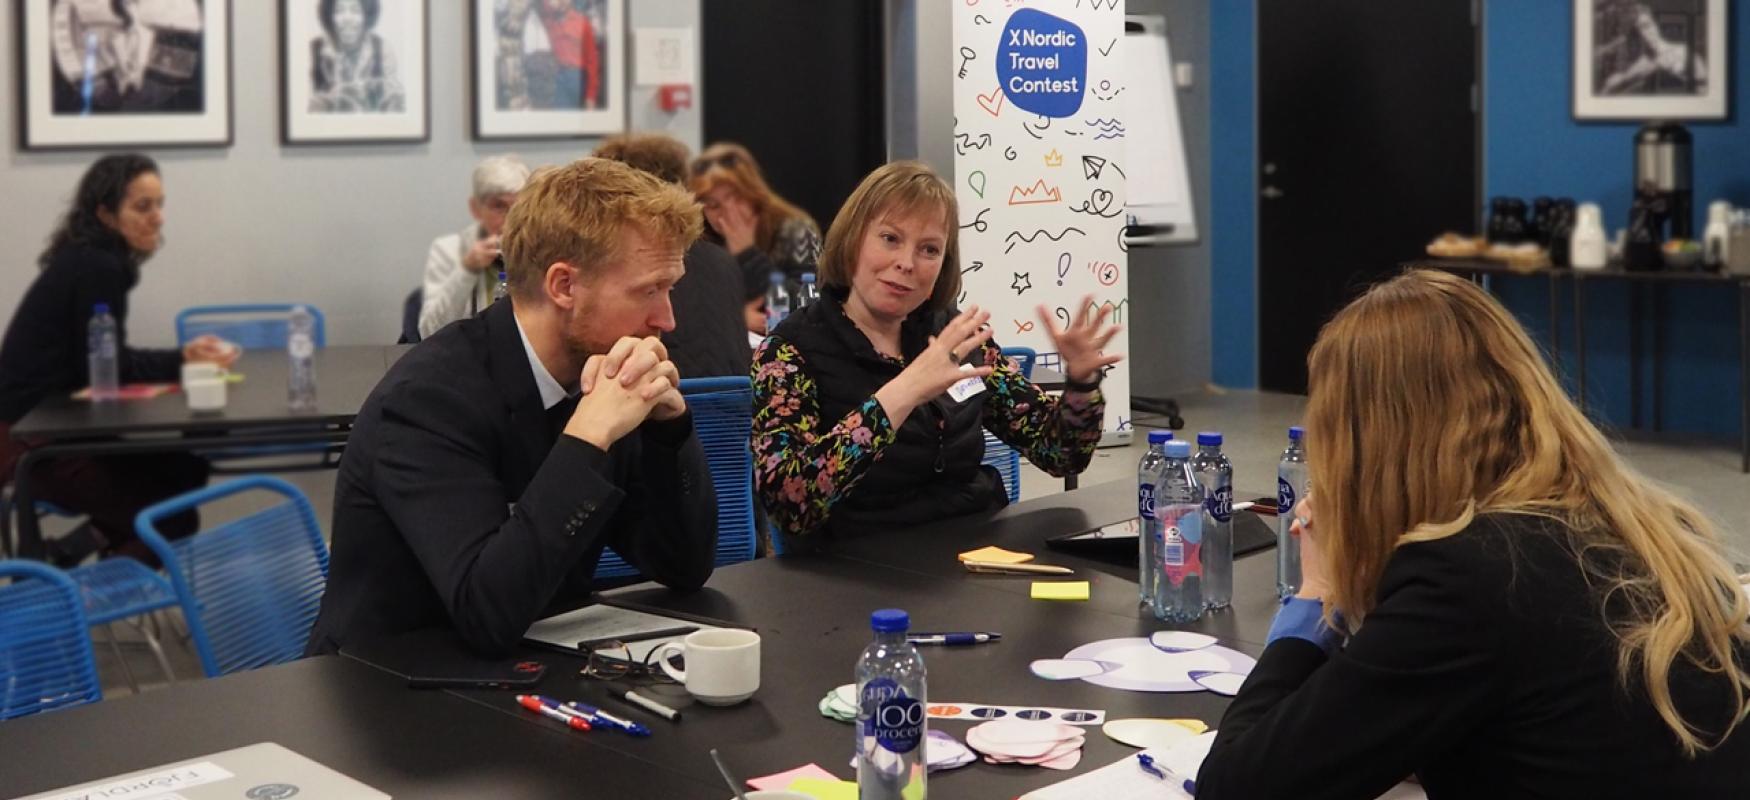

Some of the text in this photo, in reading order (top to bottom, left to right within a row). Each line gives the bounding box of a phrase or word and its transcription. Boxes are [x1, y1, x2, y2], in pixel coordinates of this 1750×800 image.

[1009, 29, 1077, 47] X Nordic
[1009, 52, 1060, 70] Travel
[1009, 76, 1079, 93] Contest
[875, 701, 924, 729] 100
